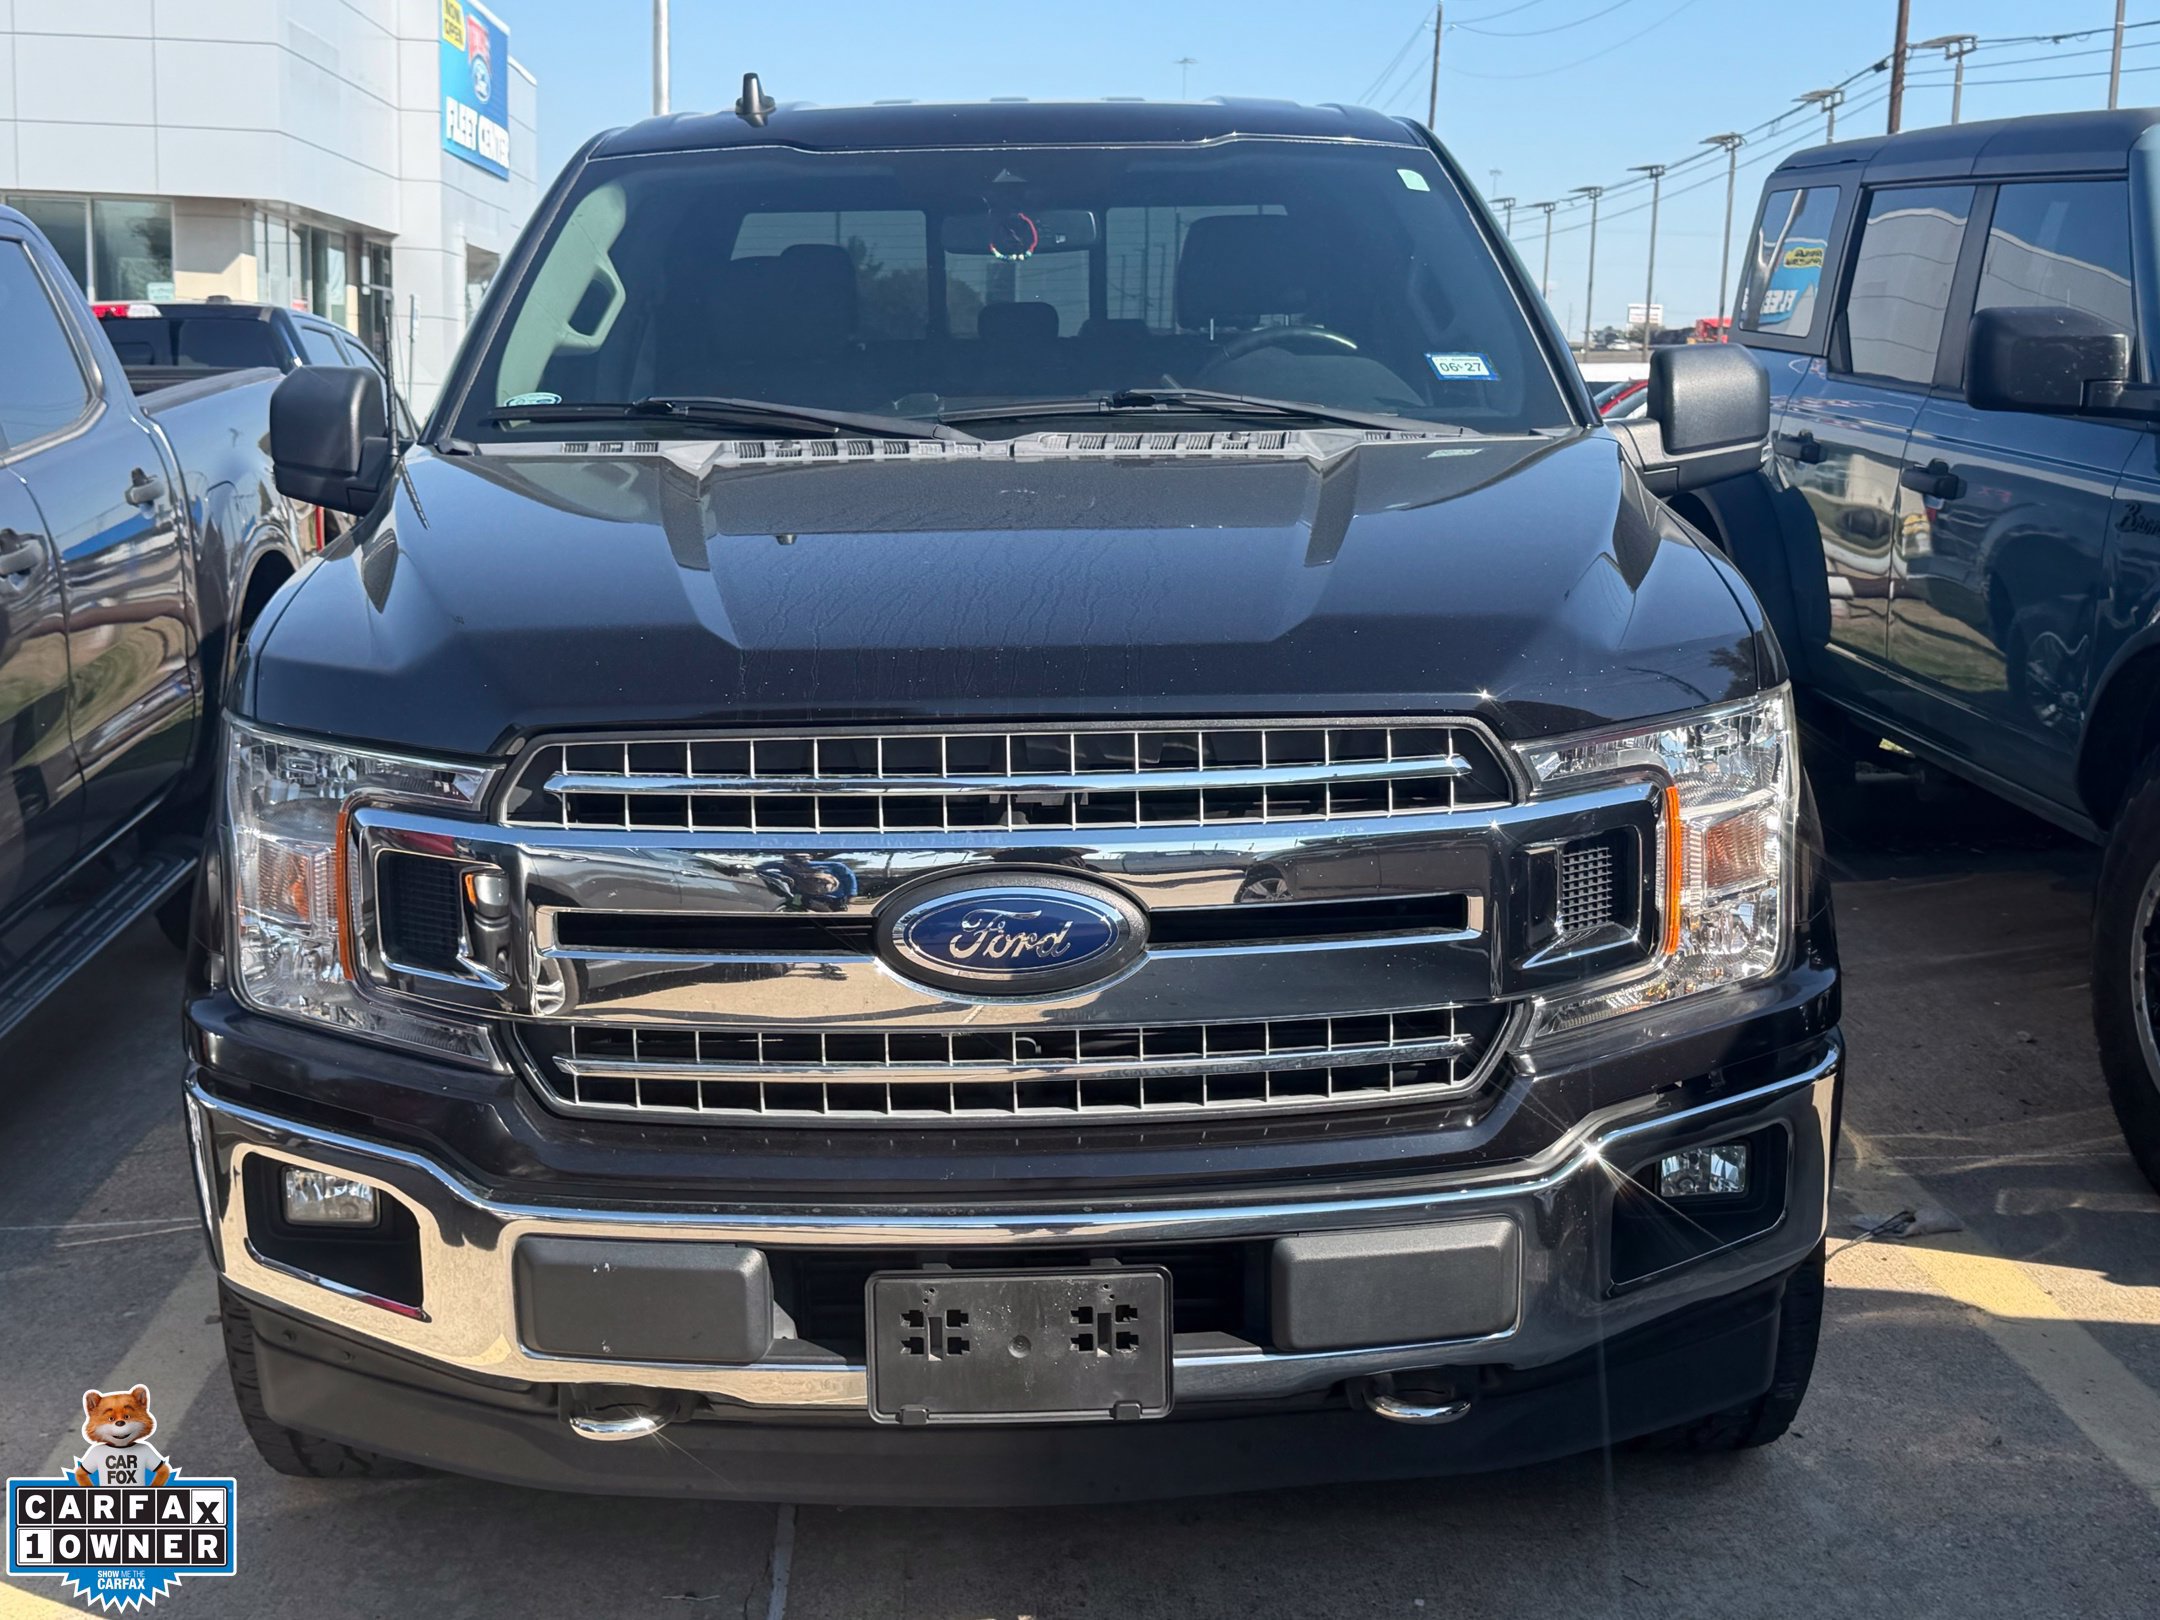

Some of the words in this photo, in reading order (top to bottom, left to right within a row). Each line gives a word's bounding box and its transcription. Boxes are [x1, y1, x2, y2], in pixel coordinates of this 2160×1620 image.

[445, 18, 463, 45] OPEN
[445, 96, 478, 151] FLEET
[479, 114, 510, 169] CENTER
[949, 908, 1074, 959] Ford
